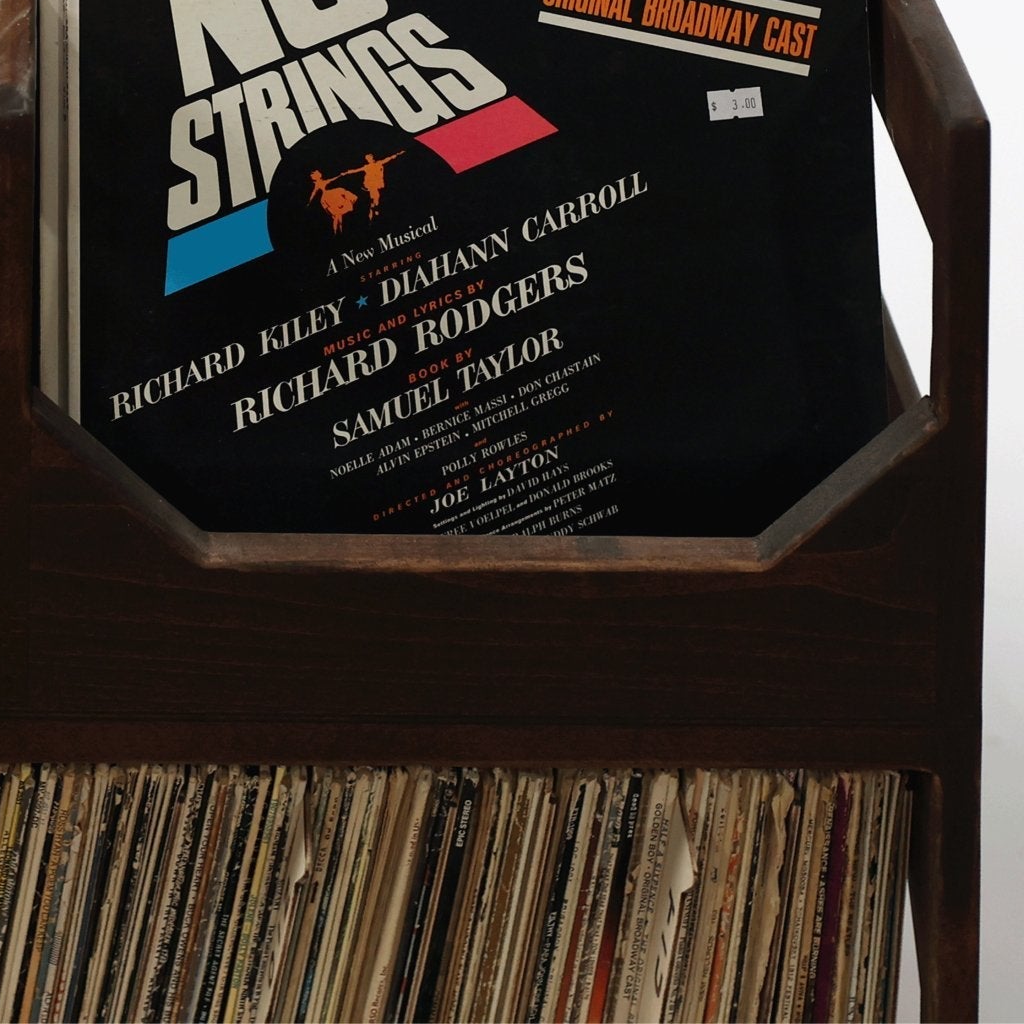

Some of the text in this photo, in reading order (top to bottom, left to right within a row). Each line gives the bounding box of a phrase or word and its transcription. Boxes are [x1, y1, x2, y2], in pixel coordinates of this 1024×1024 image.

[762, 16, 818, 59] CAST
[167, 12, 507, 231] STRINGS
[326, 215, 439, 277] A New Musical
[360, 251, 422, 282] STARRING
[109, 172, 648, 422] RICHARD KILEY DIAHANN CARROLL
[323, 280, 485, 356] MUSIC AND LYRICS BY
[230, 252, 588, 433] RICHARD RODGERS
[408, 348, 474, 384] BOOK BY
[329, 353, 601, 480] NOELLE ADAM BERNICE MASSI DON CHASTAIN
[332, 327, 564, 449] SAMUEL TAYLOR
[376, 383, 570, 476] ALVIN EPSTEIN MITCHELL GREGG
[441, 431, 528, 476] POLLY ROWLES
[373, 410, 614, 522] DIRECTED AND CHOREOGRAPHED BY
[430, 446, 561, 515] JOE LAYTON
[455, 800, 472, 847] EPIC STEREO
[165, 805, 216, 1007] OPEN YOUR HEART BUCK OWENS AND HIS
[622, 803, 663, 1000] GOLDEN BOY ORIGINAL BROADWAY CAST
[812, 915, 823, 934] ARE
[814, 881, 826, 913] ASHES
[808, 936, 820, 979] BURNING
